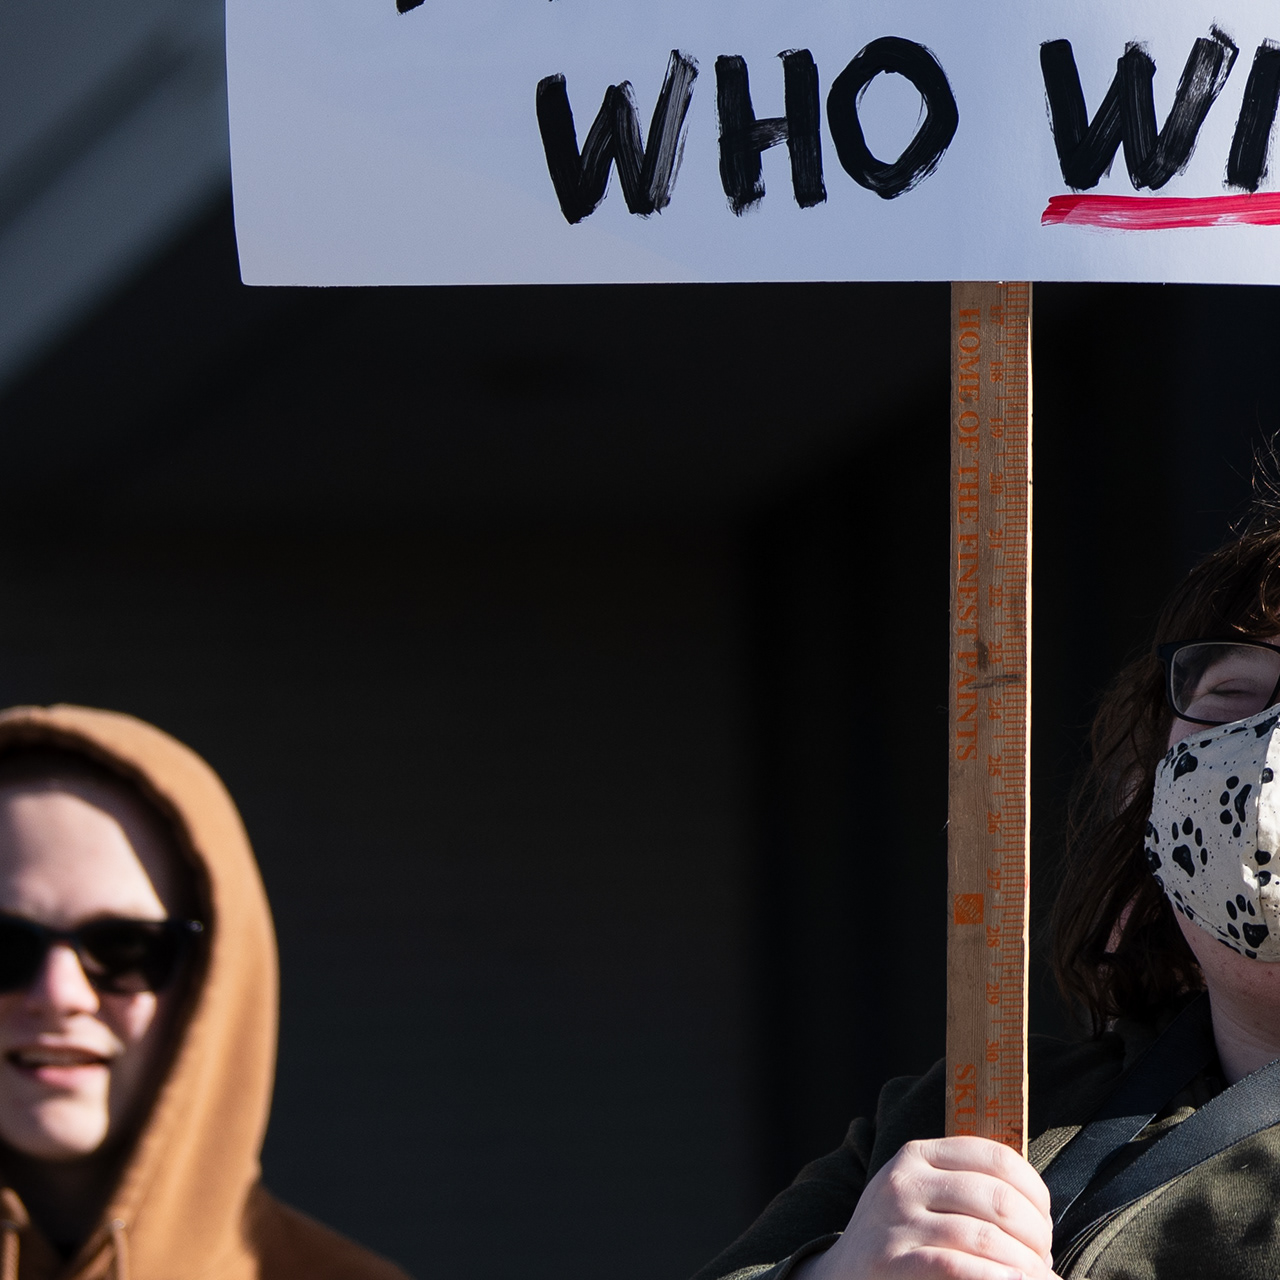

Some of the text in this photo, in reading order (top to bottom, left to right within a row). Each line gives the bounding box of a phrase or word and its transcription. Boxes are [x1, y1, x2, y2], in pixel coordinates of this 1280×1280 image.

[535, 35, 960, 226] WHO
[955, 307, 980, 761] HOME OF THE FINEST PAINTS
